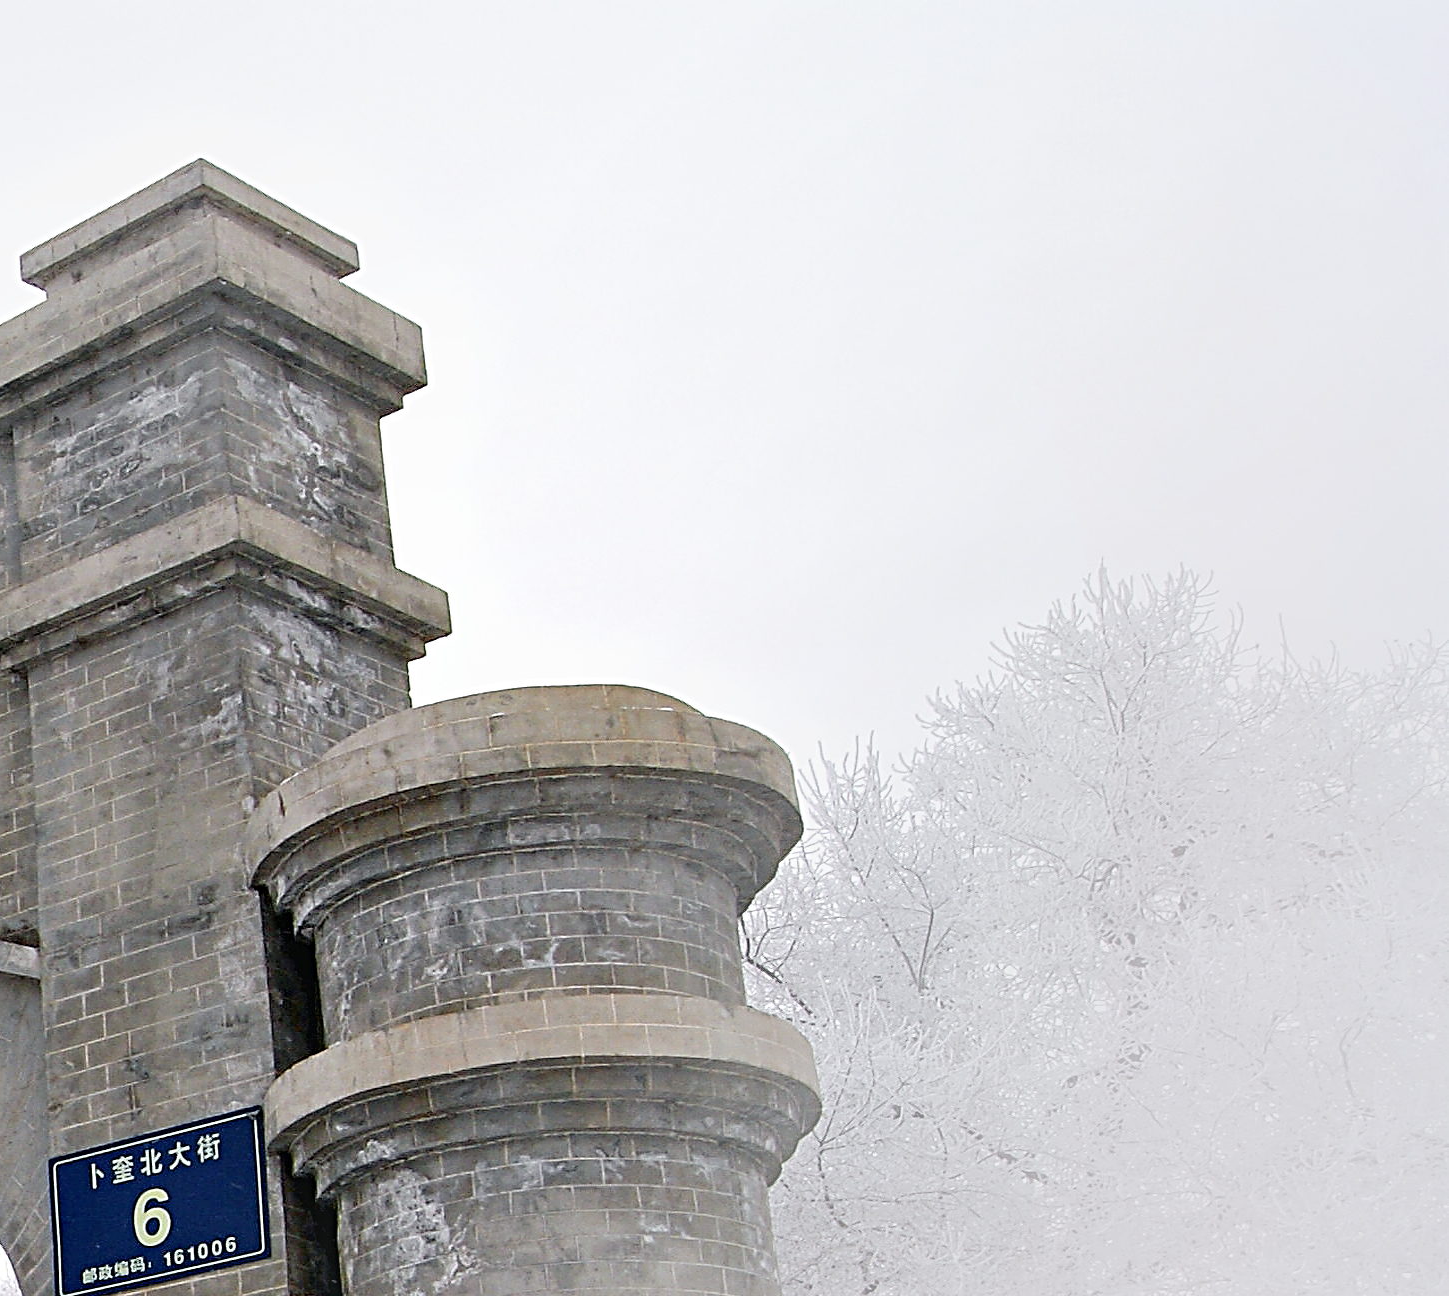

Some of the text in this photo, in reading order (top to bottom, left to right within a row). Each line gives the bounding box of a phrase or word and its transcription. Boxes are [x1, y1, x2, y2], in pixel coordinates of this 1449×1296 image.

[89, 1133, 220, 1190] 卜奎北大街
[134, 1187, 172, 1247] 6
[163, 1236, 237, 1267] 161006
